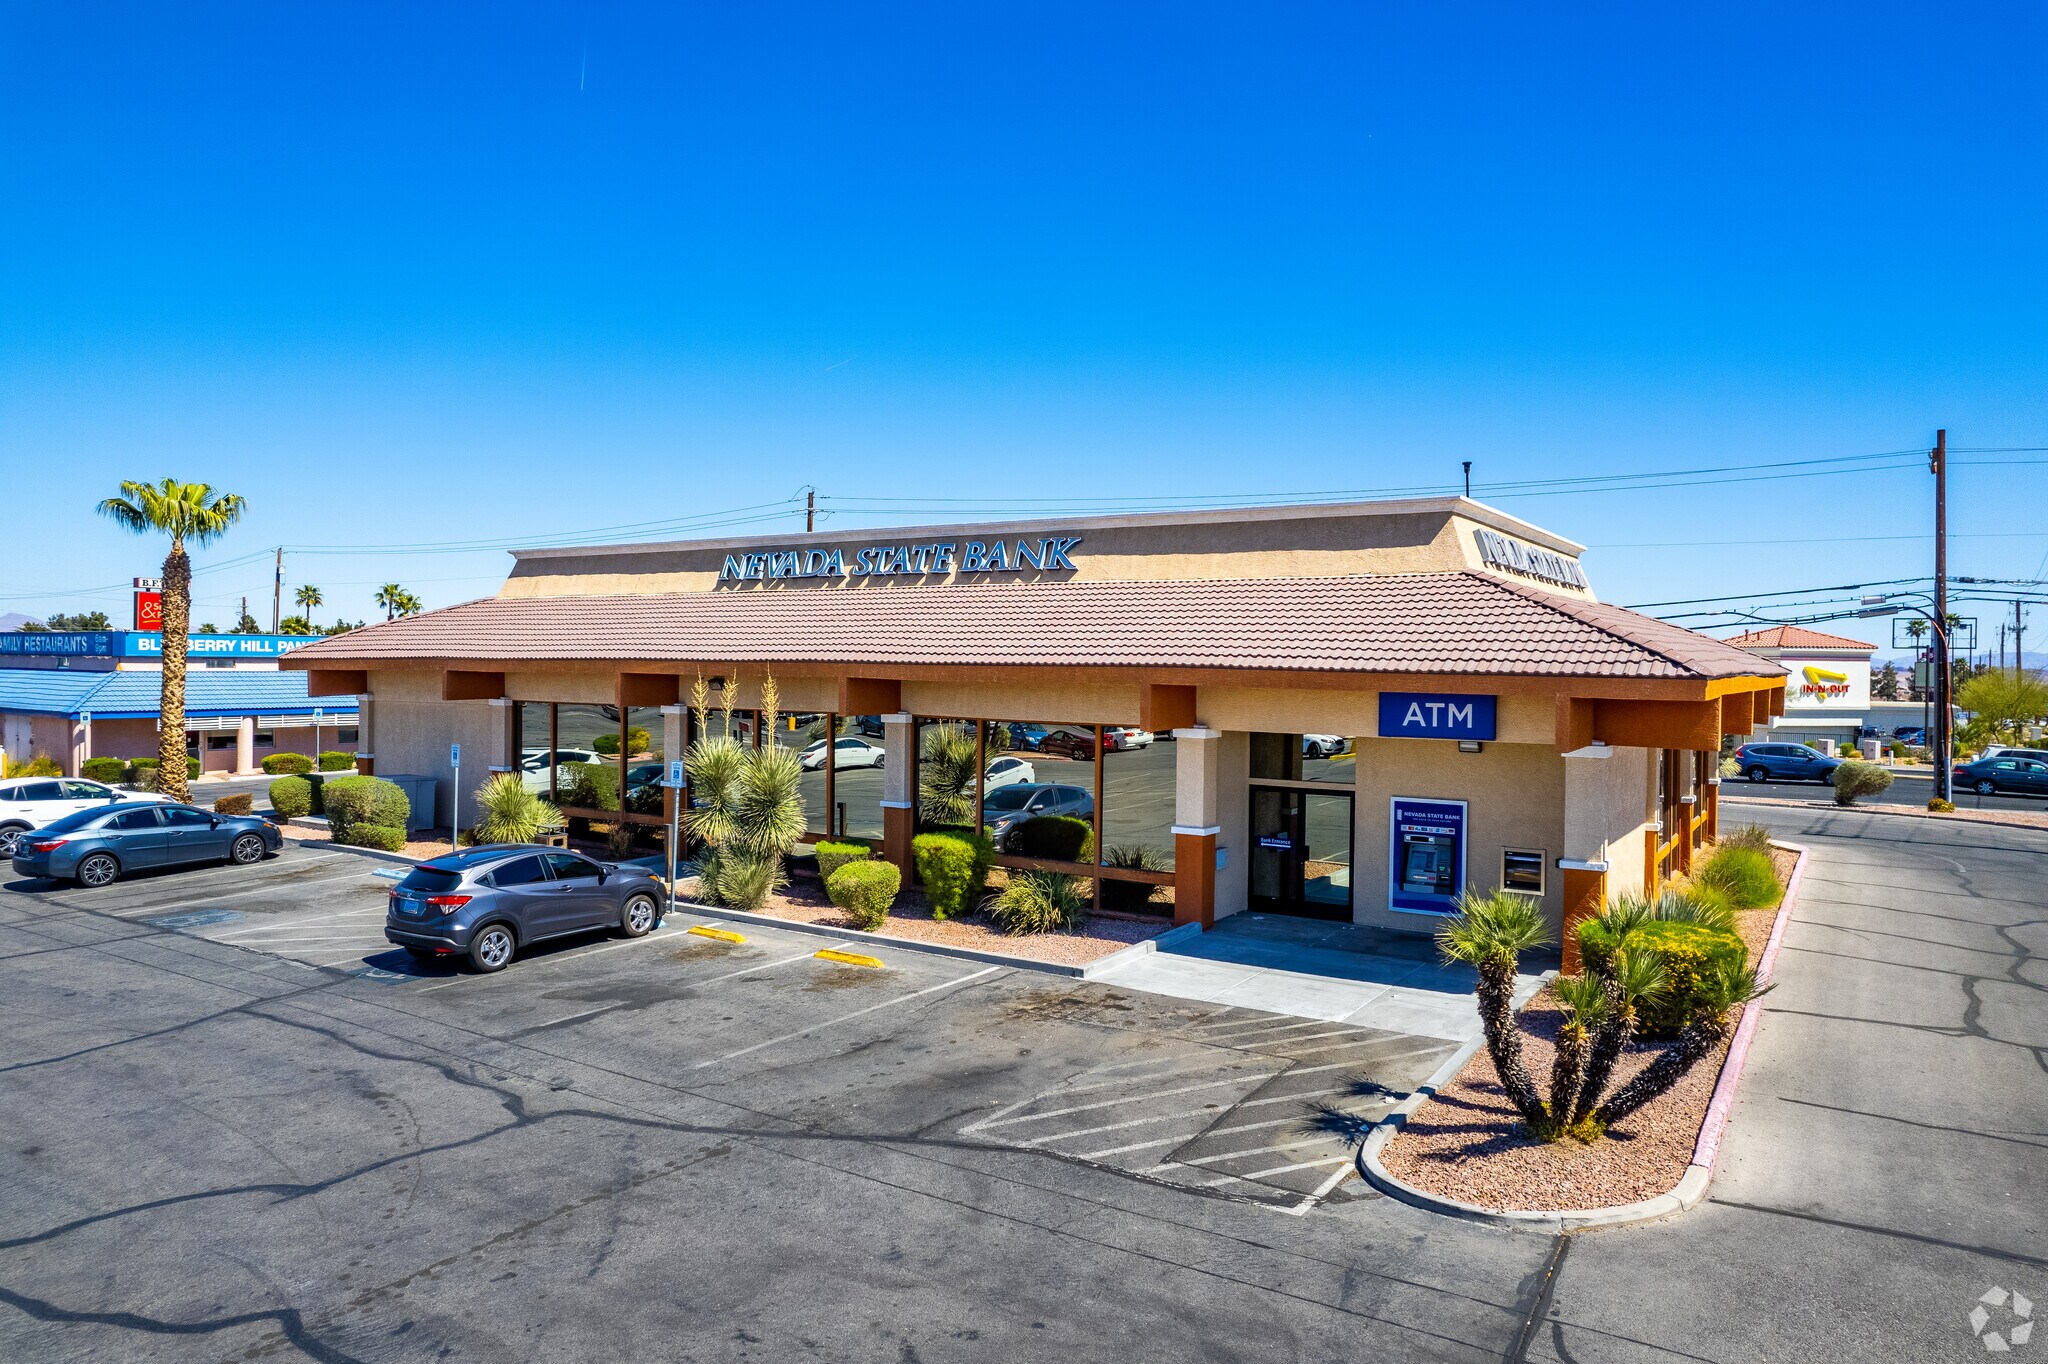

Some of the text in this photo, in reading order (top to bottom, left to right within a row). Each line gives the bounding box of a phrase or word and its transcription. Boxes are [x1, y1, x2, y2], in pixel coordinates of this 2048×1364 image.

[718, 537, 1081, 581] NEVADA STATE BANK
[24, 636, 87, 652] RESTAURANTS
[138, 638, 314, 652] BLBERRY HILL PAN
[1803, 684, 1850, 693] IN-N-OUT
[1402, 702, 1473, 728] ATM
